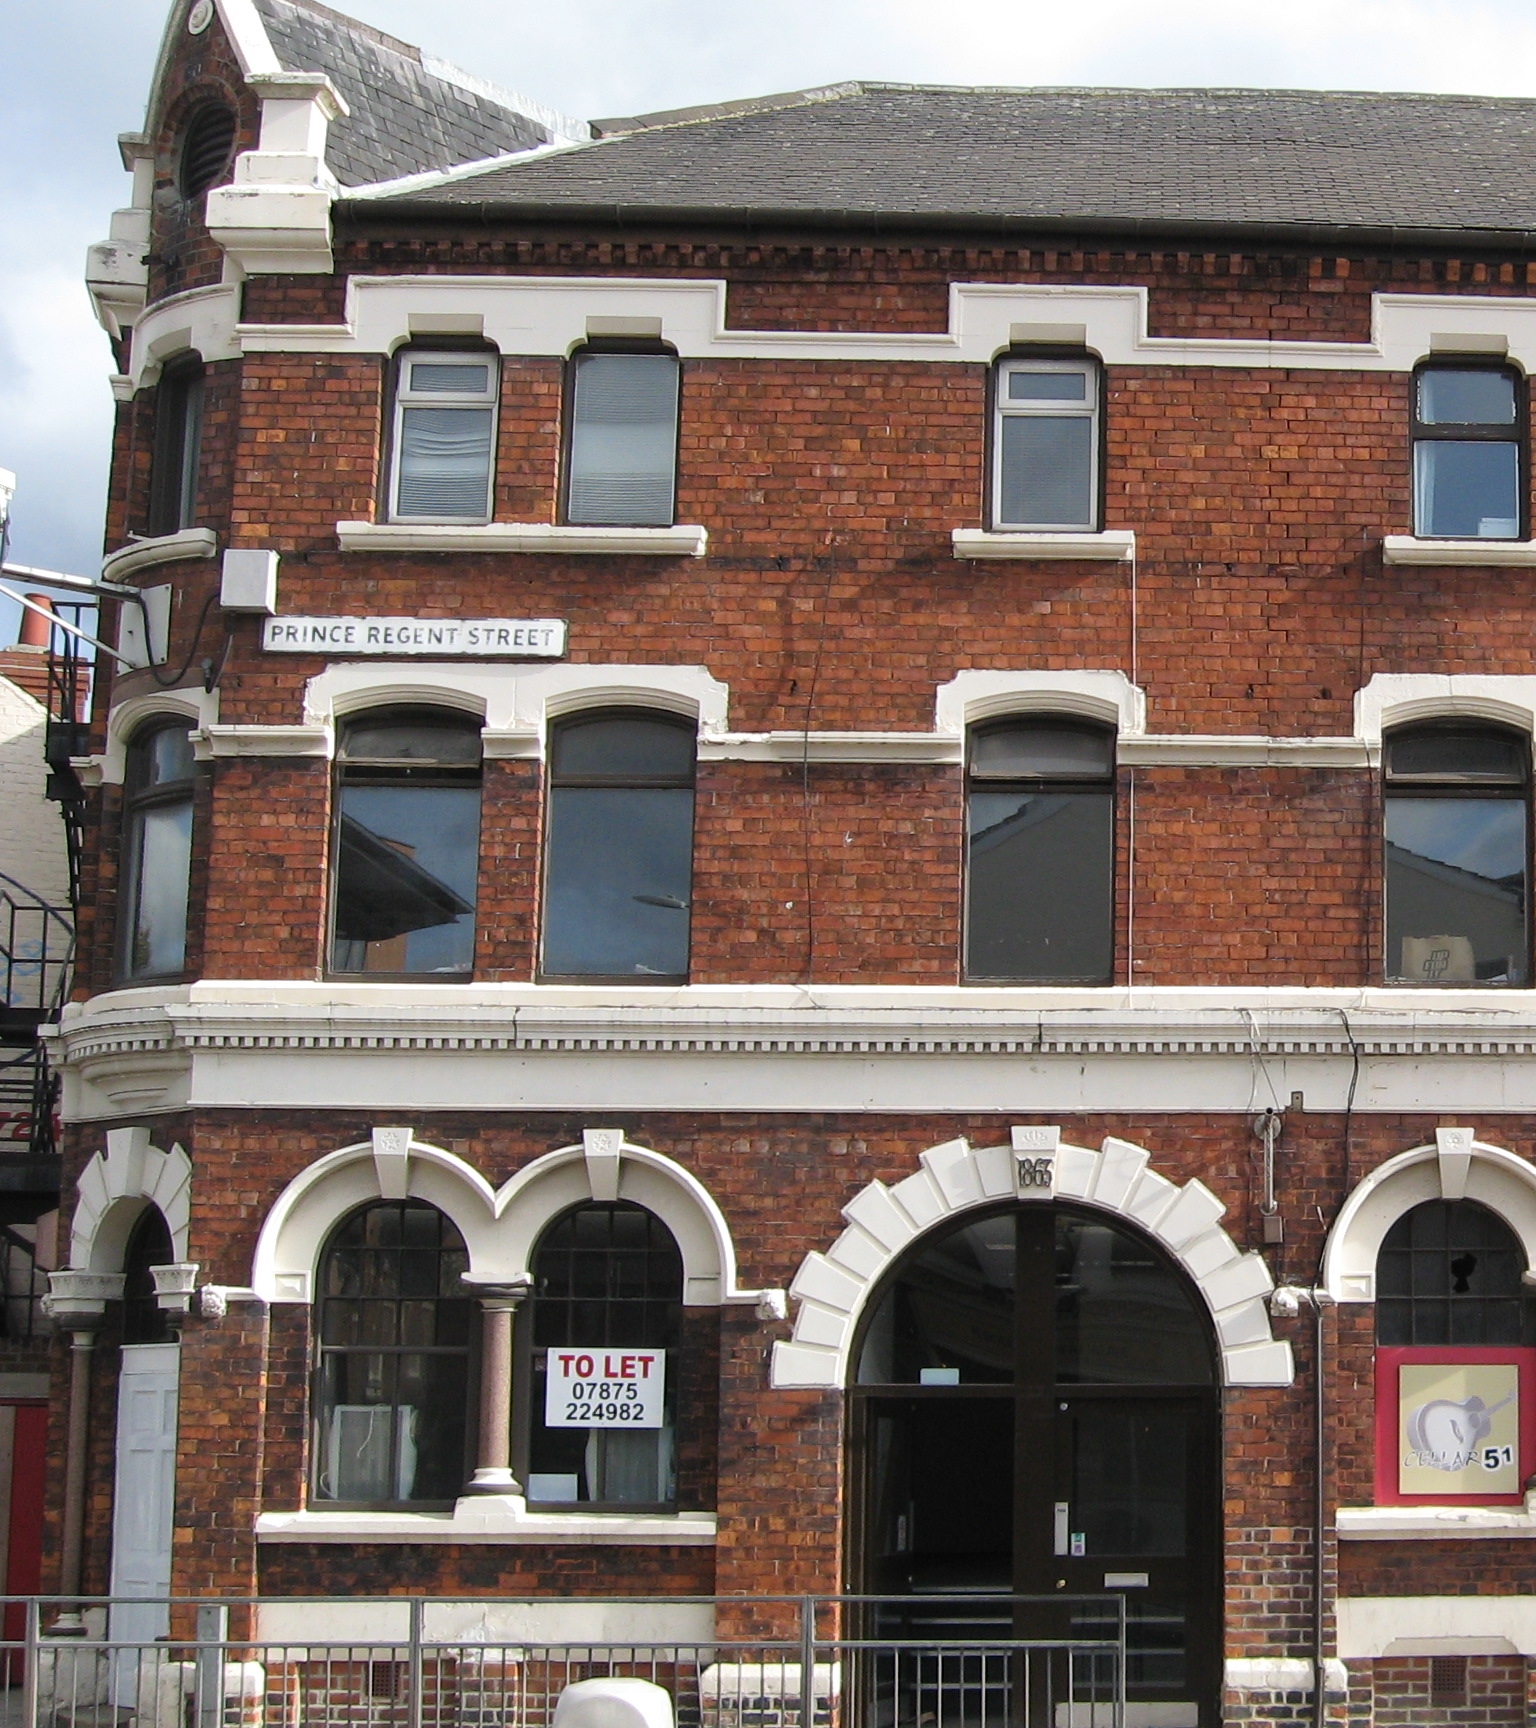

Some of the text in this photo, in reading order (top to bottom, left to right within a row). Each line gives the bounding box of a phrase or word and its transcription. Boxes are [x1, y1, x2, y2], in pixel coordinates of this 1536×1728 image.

[271, 625, 555, 647] PRINCE REGENT STREET
[558, 1355, 655, 1379] TO LET
[572, 1382, 638, 1400] 07875
[565, 1403, 645, 1421] 224982
[1402, 1447, 1512, 1469] CELLAR 51
